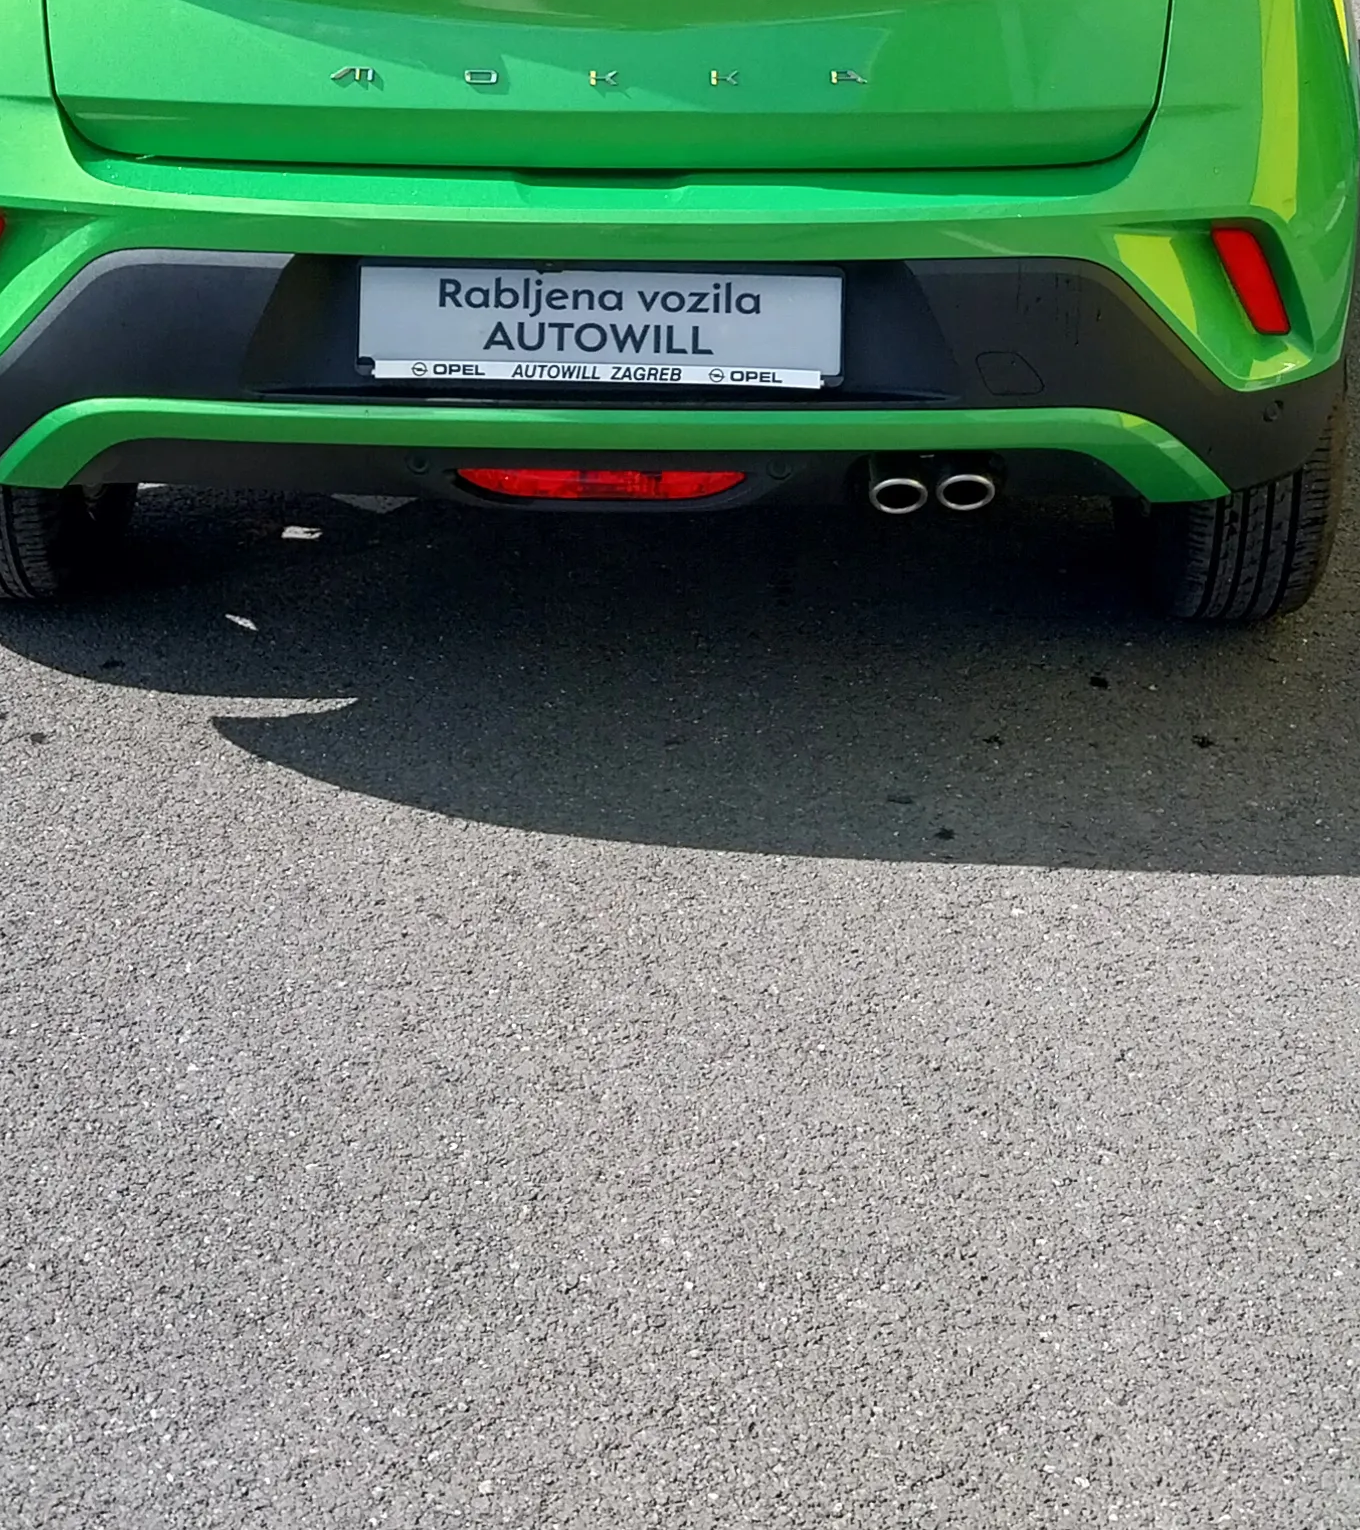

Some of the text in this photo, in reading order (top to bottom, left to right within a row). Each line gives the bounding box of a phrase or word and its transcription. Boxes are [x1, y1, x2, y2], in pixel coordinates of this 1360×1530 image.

[438, 277, 762, 317] Rabljena vozila
[483, 321, 715, 356] AUTOWILL
[432, 363, 783, 384] OPEL AUTOWILL ZAGREB OPEL
